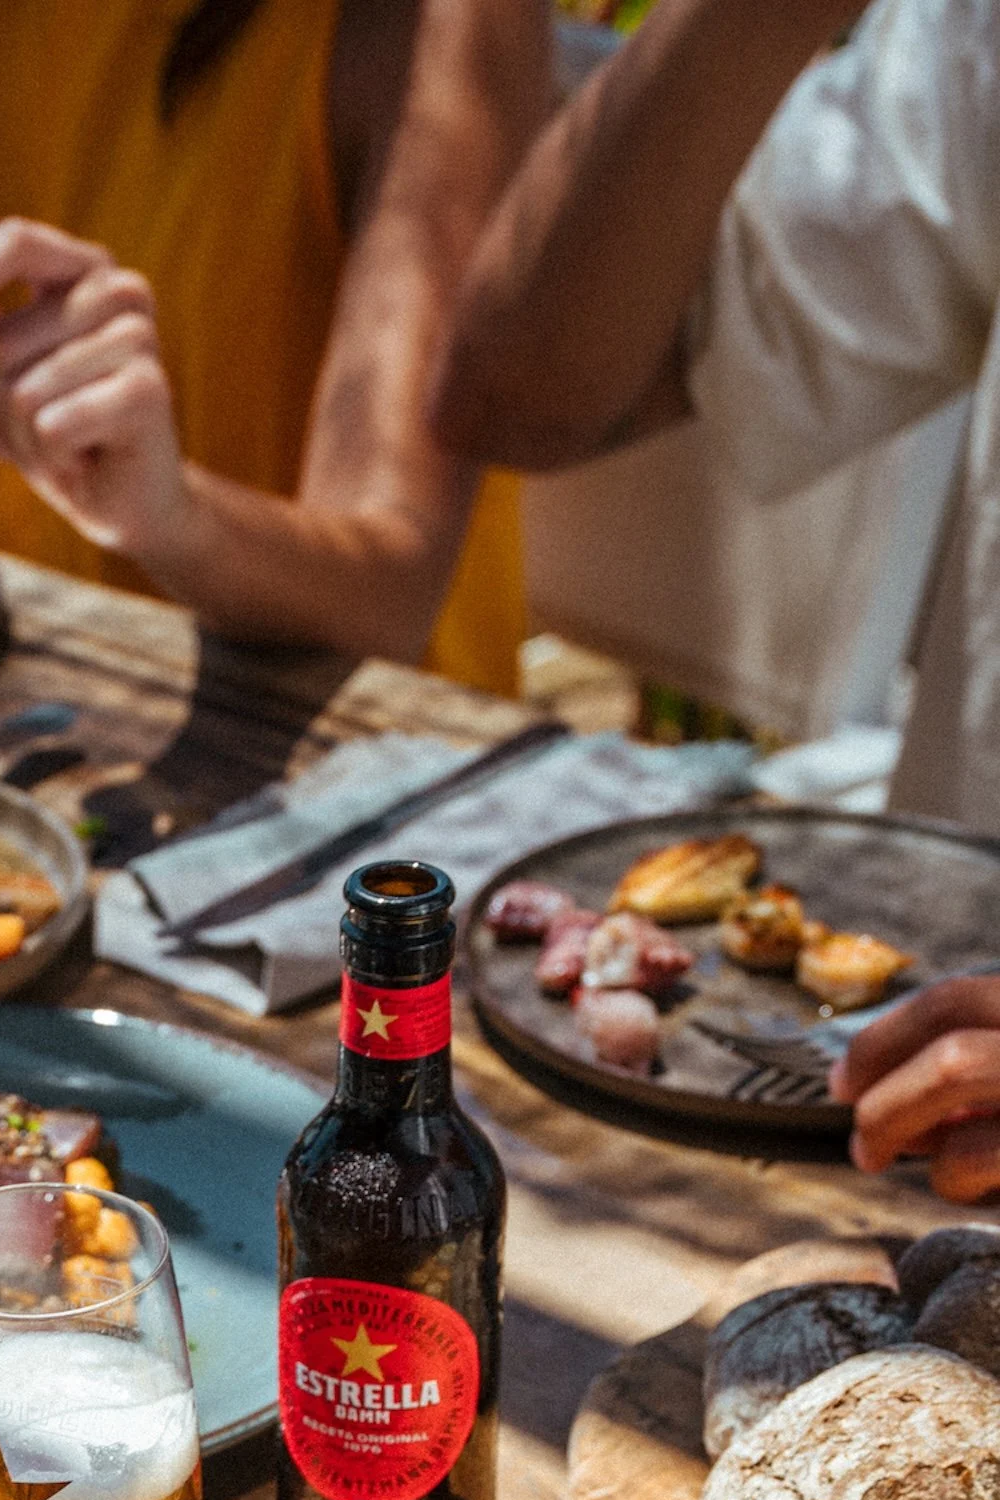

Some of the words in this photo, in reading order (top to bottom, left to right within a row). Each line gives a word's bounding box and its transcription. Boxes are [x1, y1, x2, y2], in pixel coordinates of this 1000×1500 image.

[295, 1361, 441, 1410] ESTRELLA
[302, 1415, 354, 1441] RECETA
[356, 1432, 430, 1445] ORIGINAL
[334, 1405, 391, 1425] DAMM
